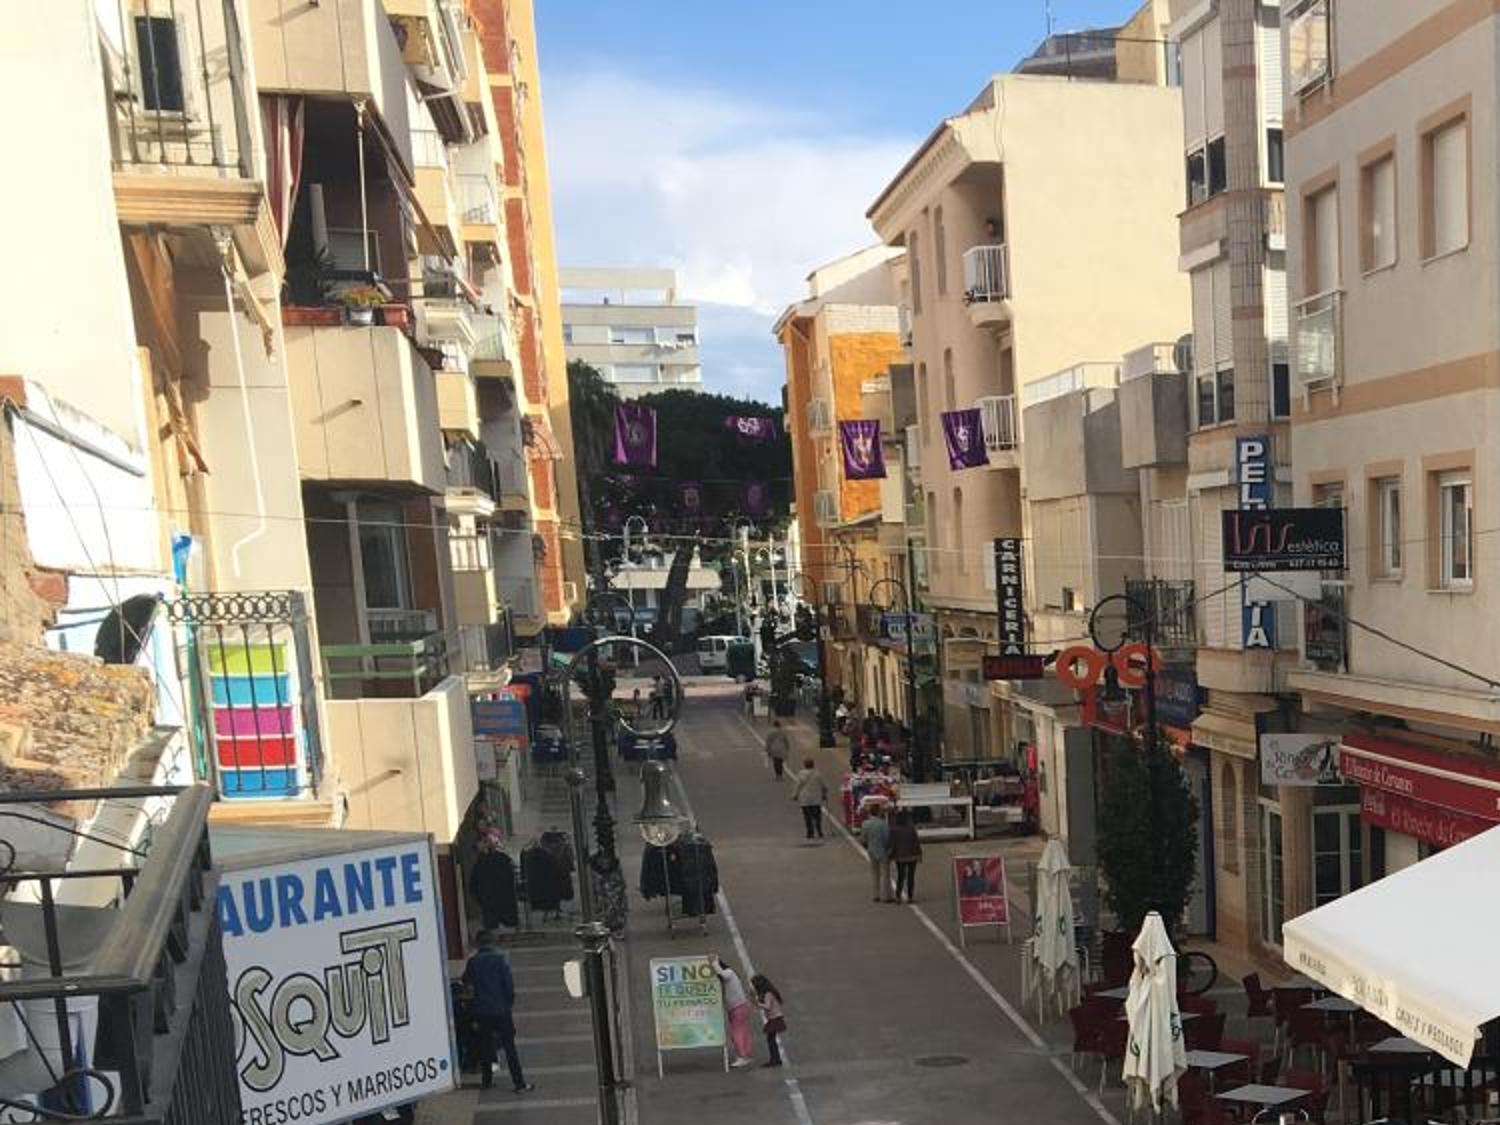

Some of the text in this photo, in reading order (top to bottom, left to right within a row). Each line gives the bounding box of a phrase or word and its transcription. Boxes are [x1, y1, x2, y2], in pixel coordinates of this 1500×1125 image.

[1001, 540, 1020, 655] CARNICERIA
[656, 963, 714, 983] SI NO
[332, 1084, 342, 1108] Y
[347, 1057, 438, 1103] MARISCOS
